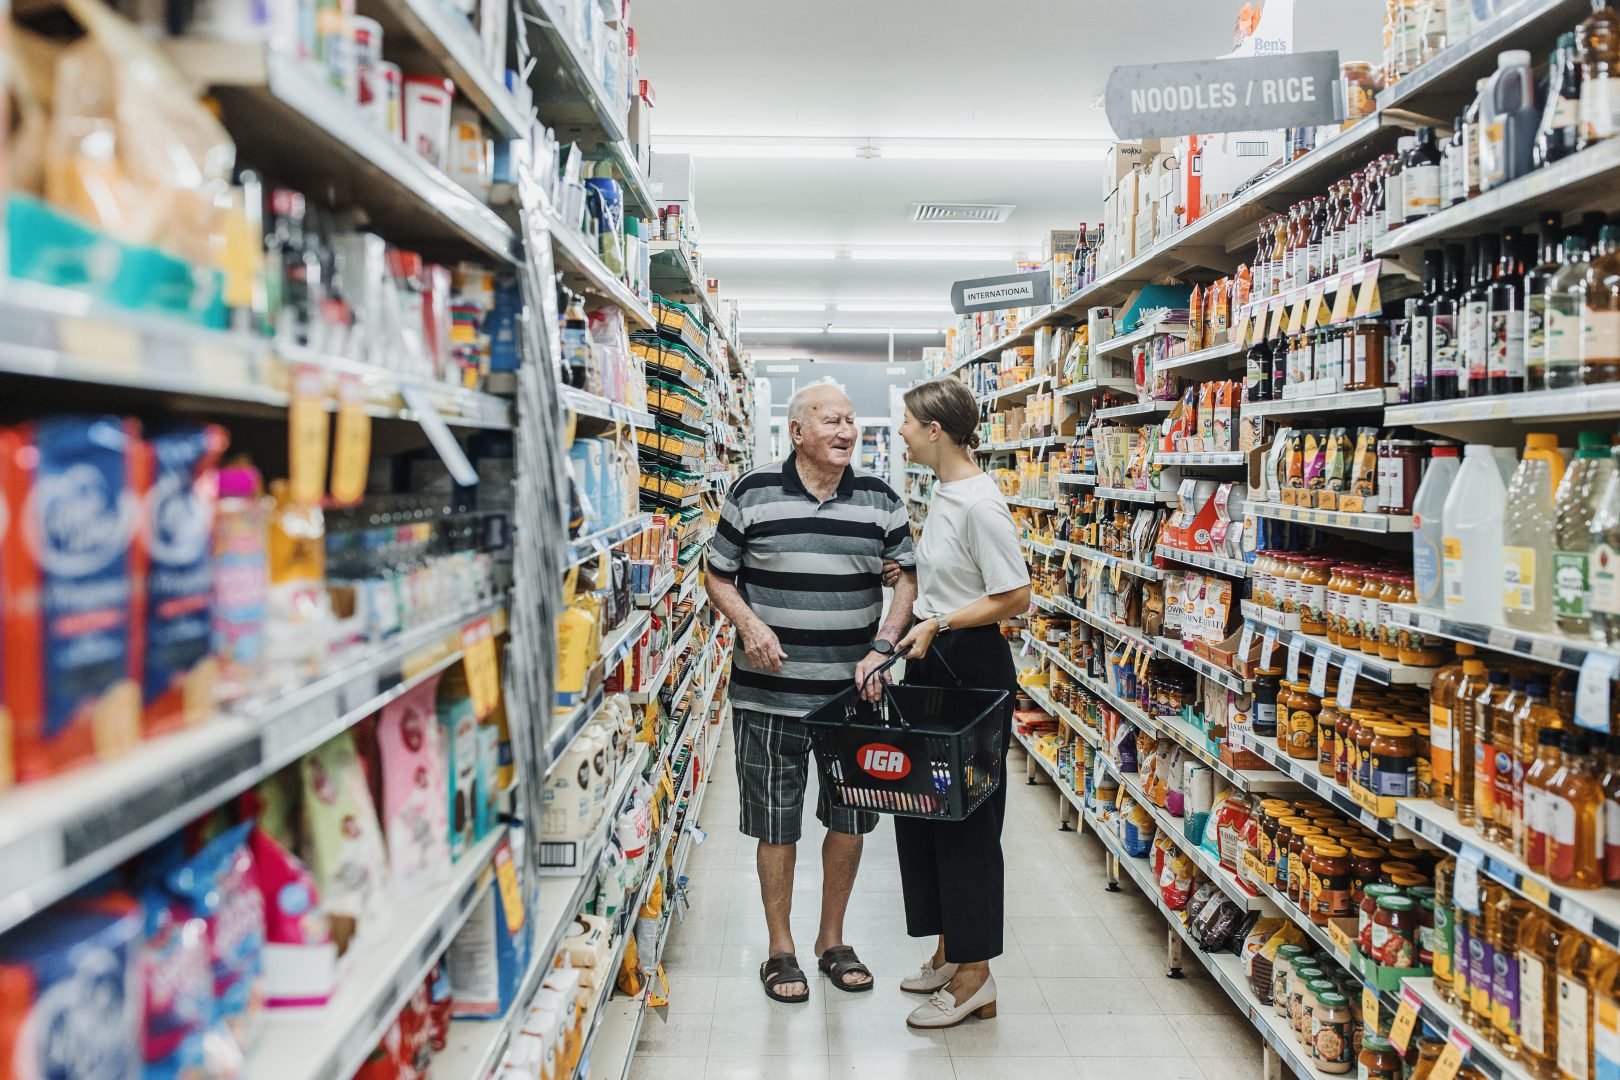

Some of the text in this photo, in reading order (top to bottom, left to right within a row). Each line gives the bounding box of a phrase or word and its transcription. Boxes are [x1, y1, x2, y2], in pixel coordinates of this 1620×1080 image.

[1254, 38, 1287, 51] Ben's
[1131, 76, 1317, 114] NOODLES / RICE
[967, 285, 1030, 301] INTERNATIONAL
